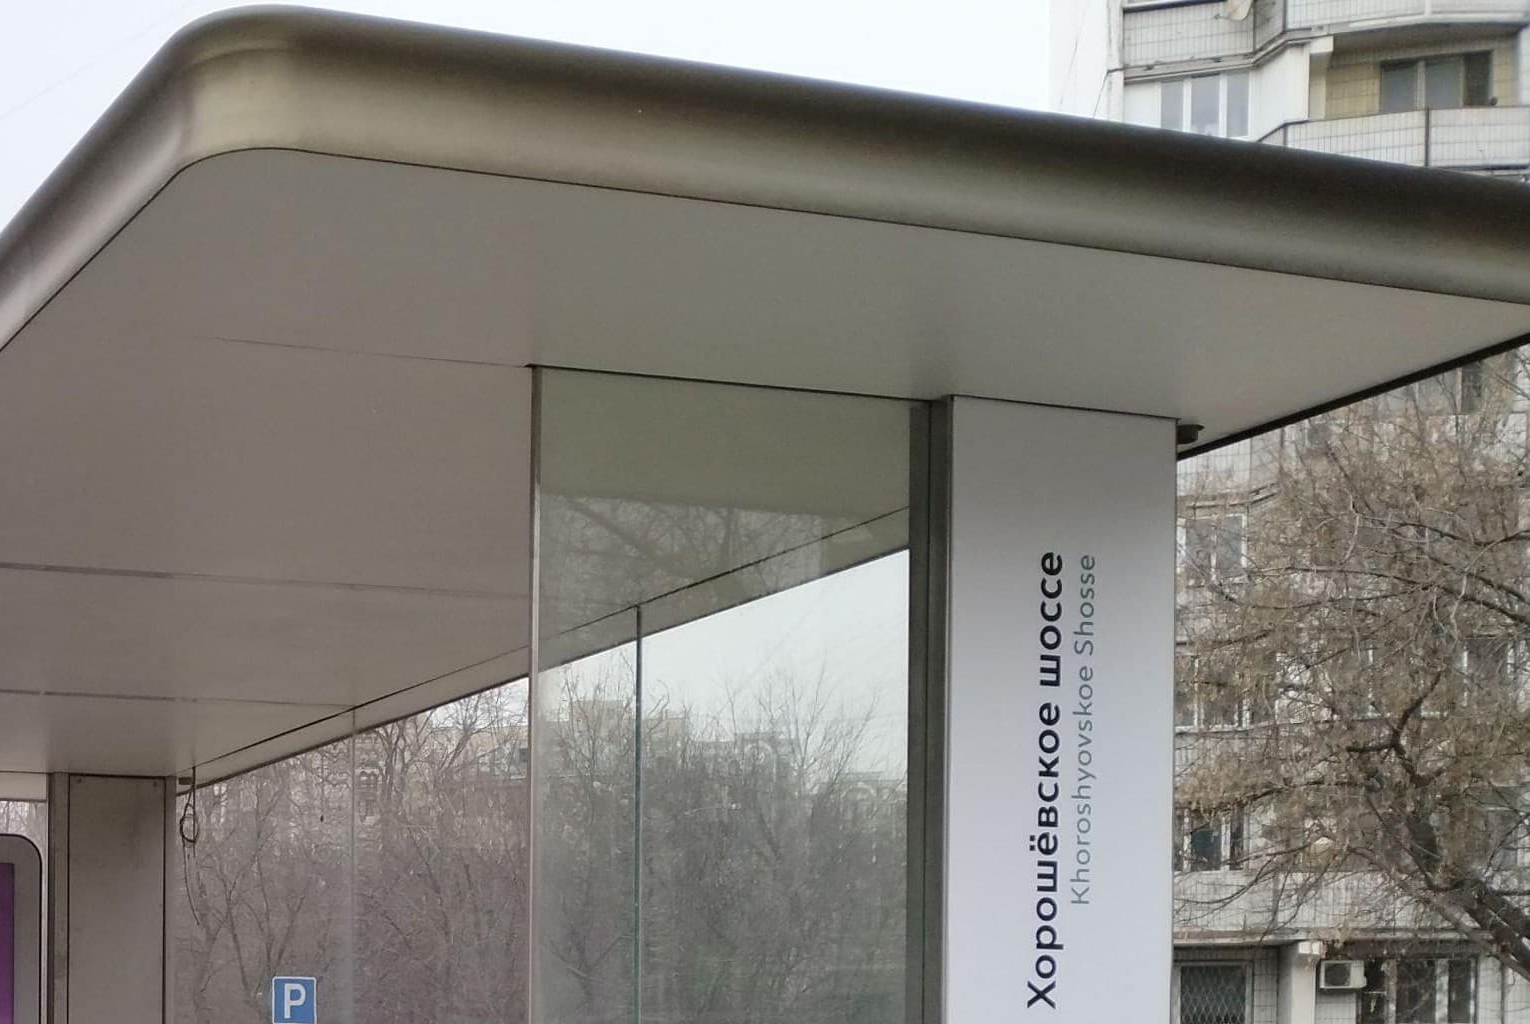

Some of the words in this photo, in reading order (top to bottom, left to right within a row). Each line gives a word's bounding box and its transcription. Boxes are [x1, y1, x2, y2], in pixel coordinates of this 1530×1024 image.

[1039, 551, 1063, 687] шоссе
[1073, 554, 1095, 656] Shosse
[1070, 666, 1096, 904] Khoroshyovskoe
[1026, 701, 1064, 1010] Хорошёвское
[284, 983, 306, 1019] P
